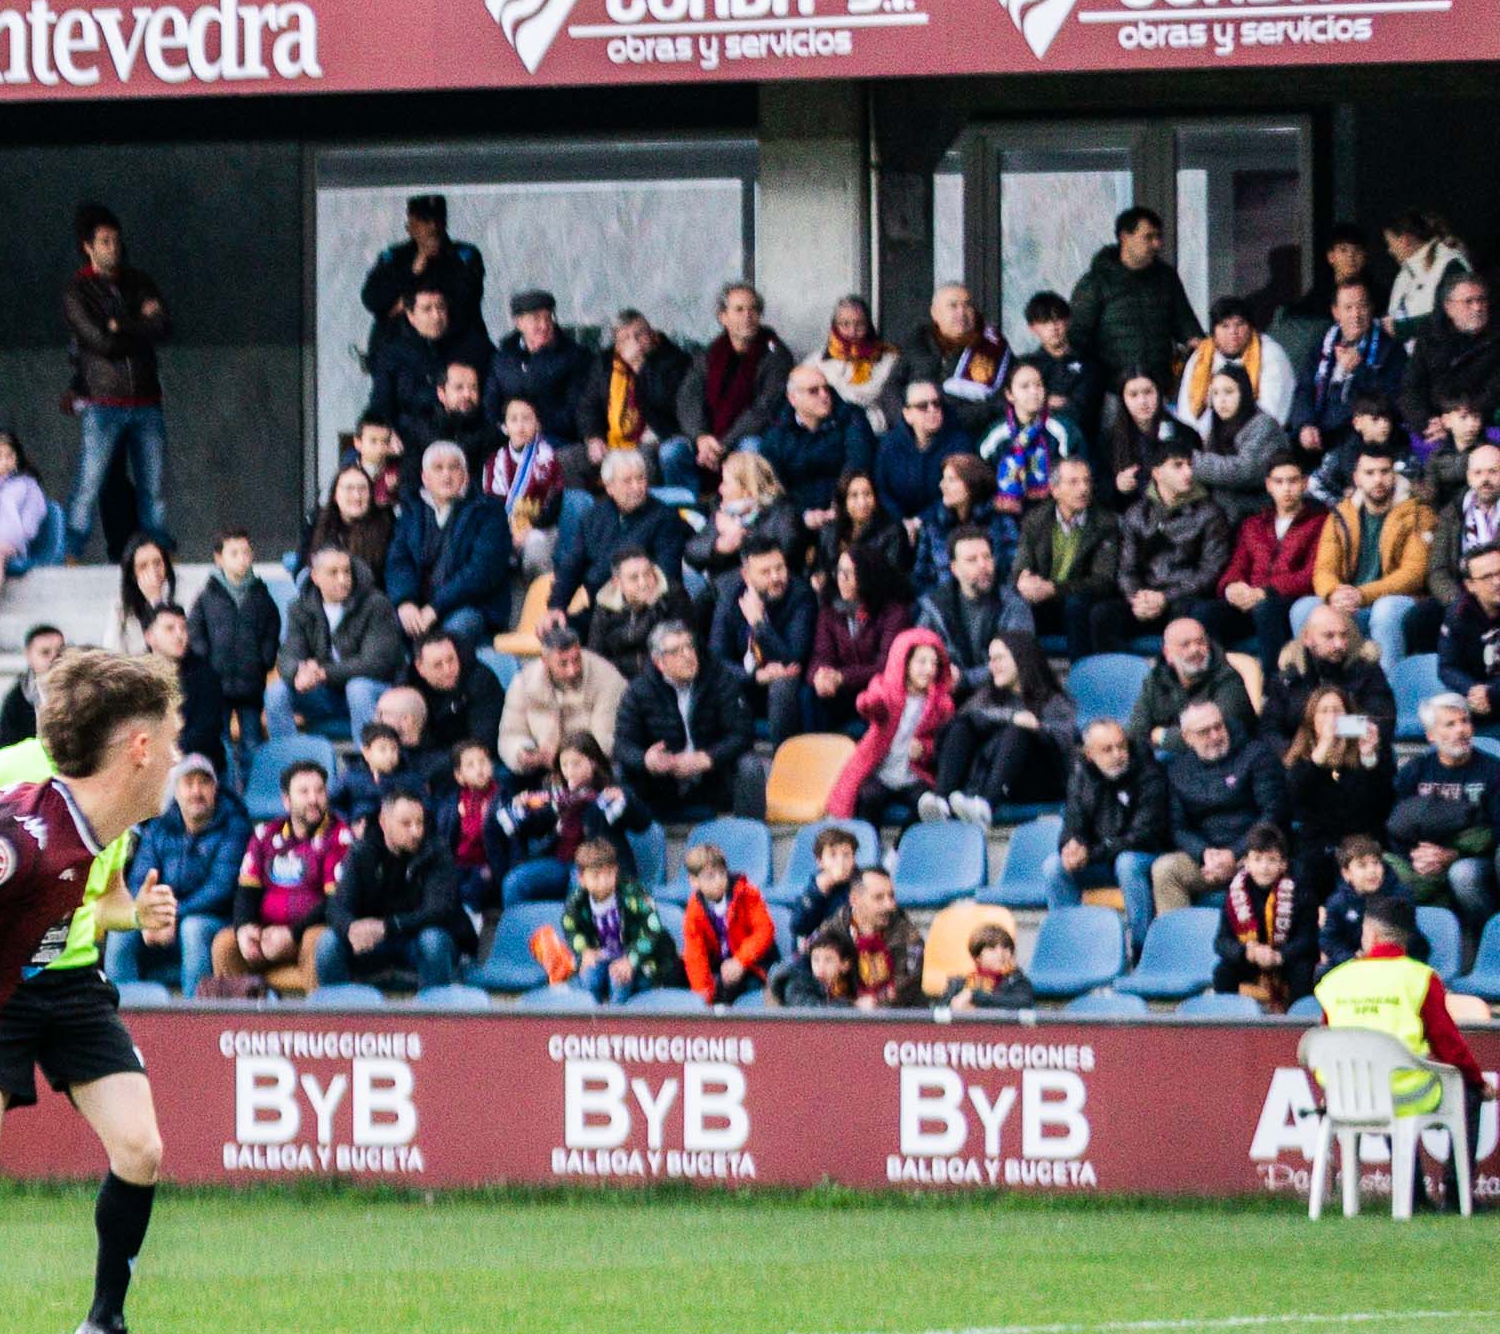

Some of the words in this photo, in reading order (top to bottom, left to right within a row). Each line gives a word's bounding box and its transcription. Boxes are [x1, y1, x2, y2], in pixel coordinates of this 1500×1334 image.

[606, 30, 695, 66] obras
[702, 38, 725, 70] y
[731, 24, 854, 61] servicios
[1116, 17, 1205, 53] obras
[1210, 23, 1235, 58] y
[1240, 11, 1373, 47] servicios
[219, 1030, 422, 1061] CONSTRUCCIONES
[548, 1033, 755, 1066] CONSTRUCCIONES
[883, 1040, 1096, 1071] CONSTRUCCIONES
[223, 1142, 314, 1171] BALBOA
[317, 1143, 332, 1172] Y
[336, 1143, 425, 1173] BUCETA
[552, 1146, 644, 1177] BALBOA
[647, 1147, 662, 1178] Y
[664, 1147, 757, 1179] BUCETA
[885, 1153, 982, 1185] BALBOA
[984, 1154, 999, 1186] Y
[1001, 1154, 1099, 1187] BUCETA
